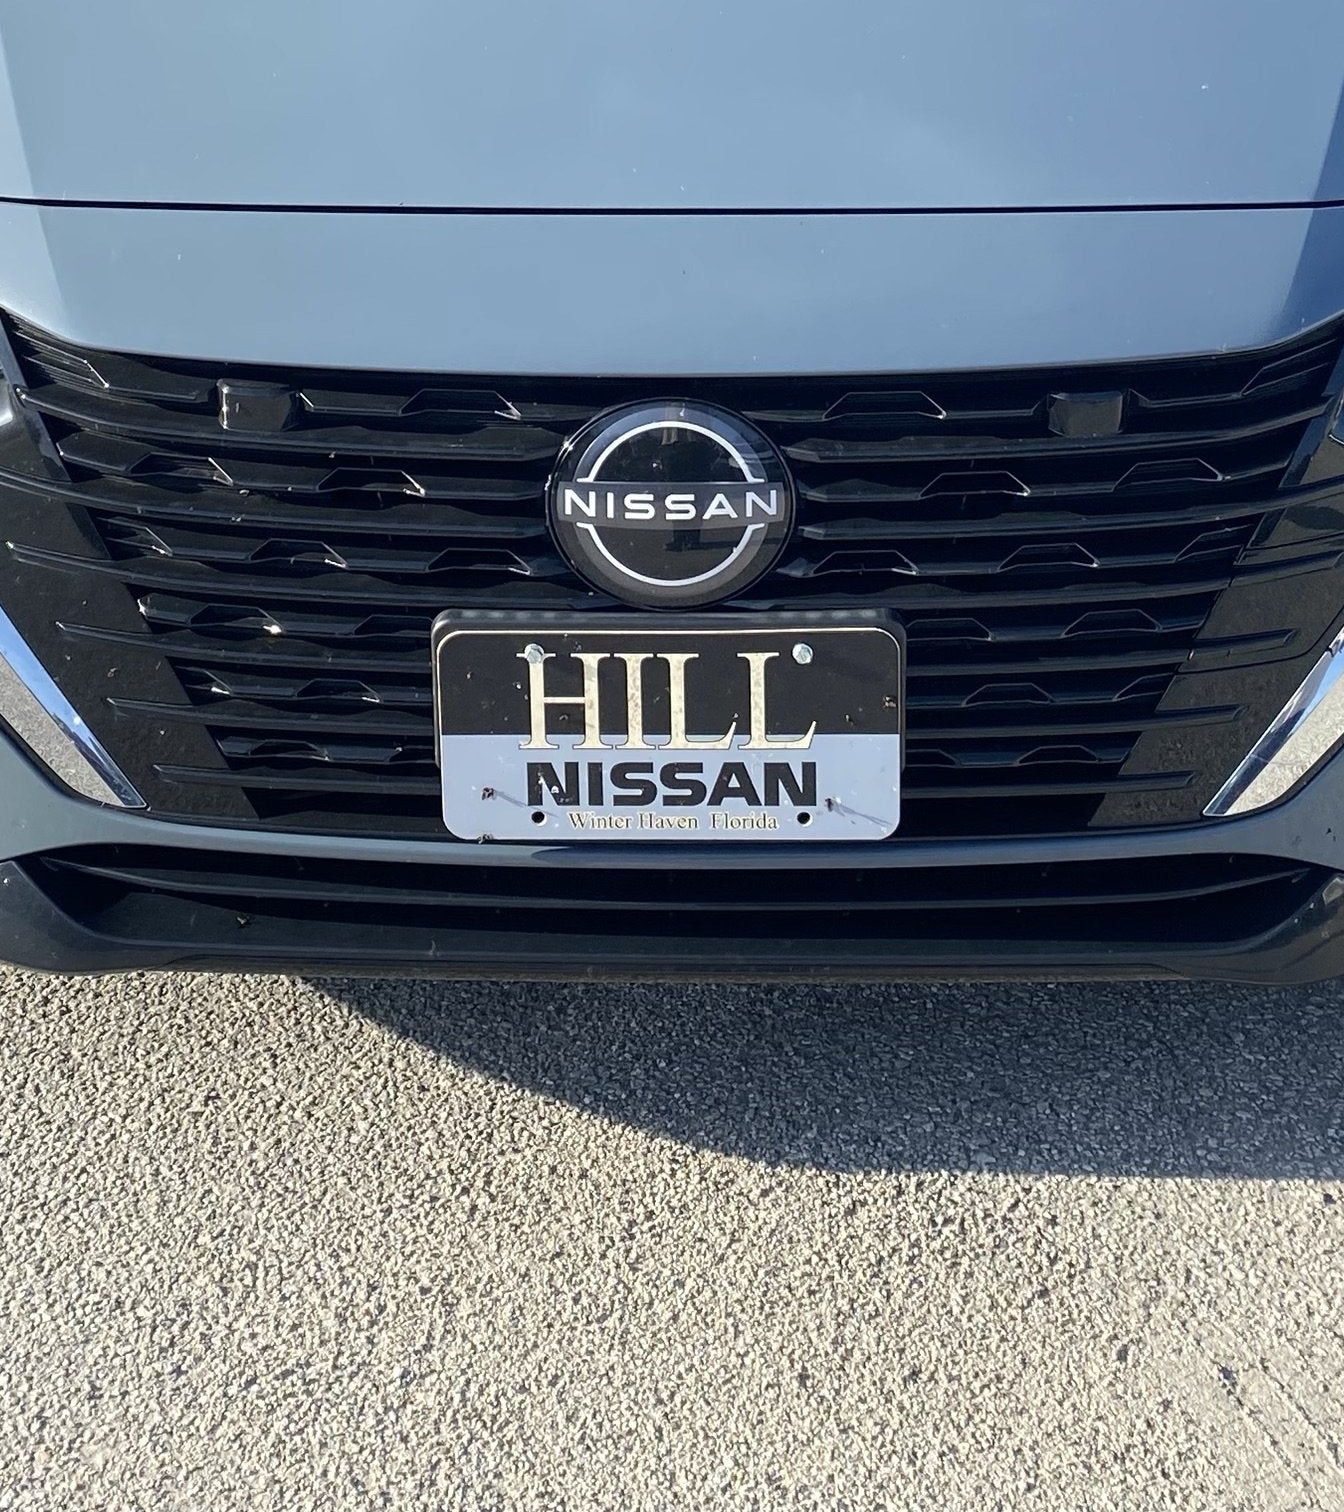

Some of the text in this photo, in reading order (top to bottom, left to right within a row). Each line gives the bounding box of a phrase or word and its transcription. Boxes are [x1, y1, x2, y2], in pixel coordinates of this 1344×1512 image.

[564, 488, 778, 521] NISSAN
[515, 651, 818, 751] HILL
[526, 760, 818, 808] NISSAN
[568, 812, 779, 830] Winter Haven Florida
